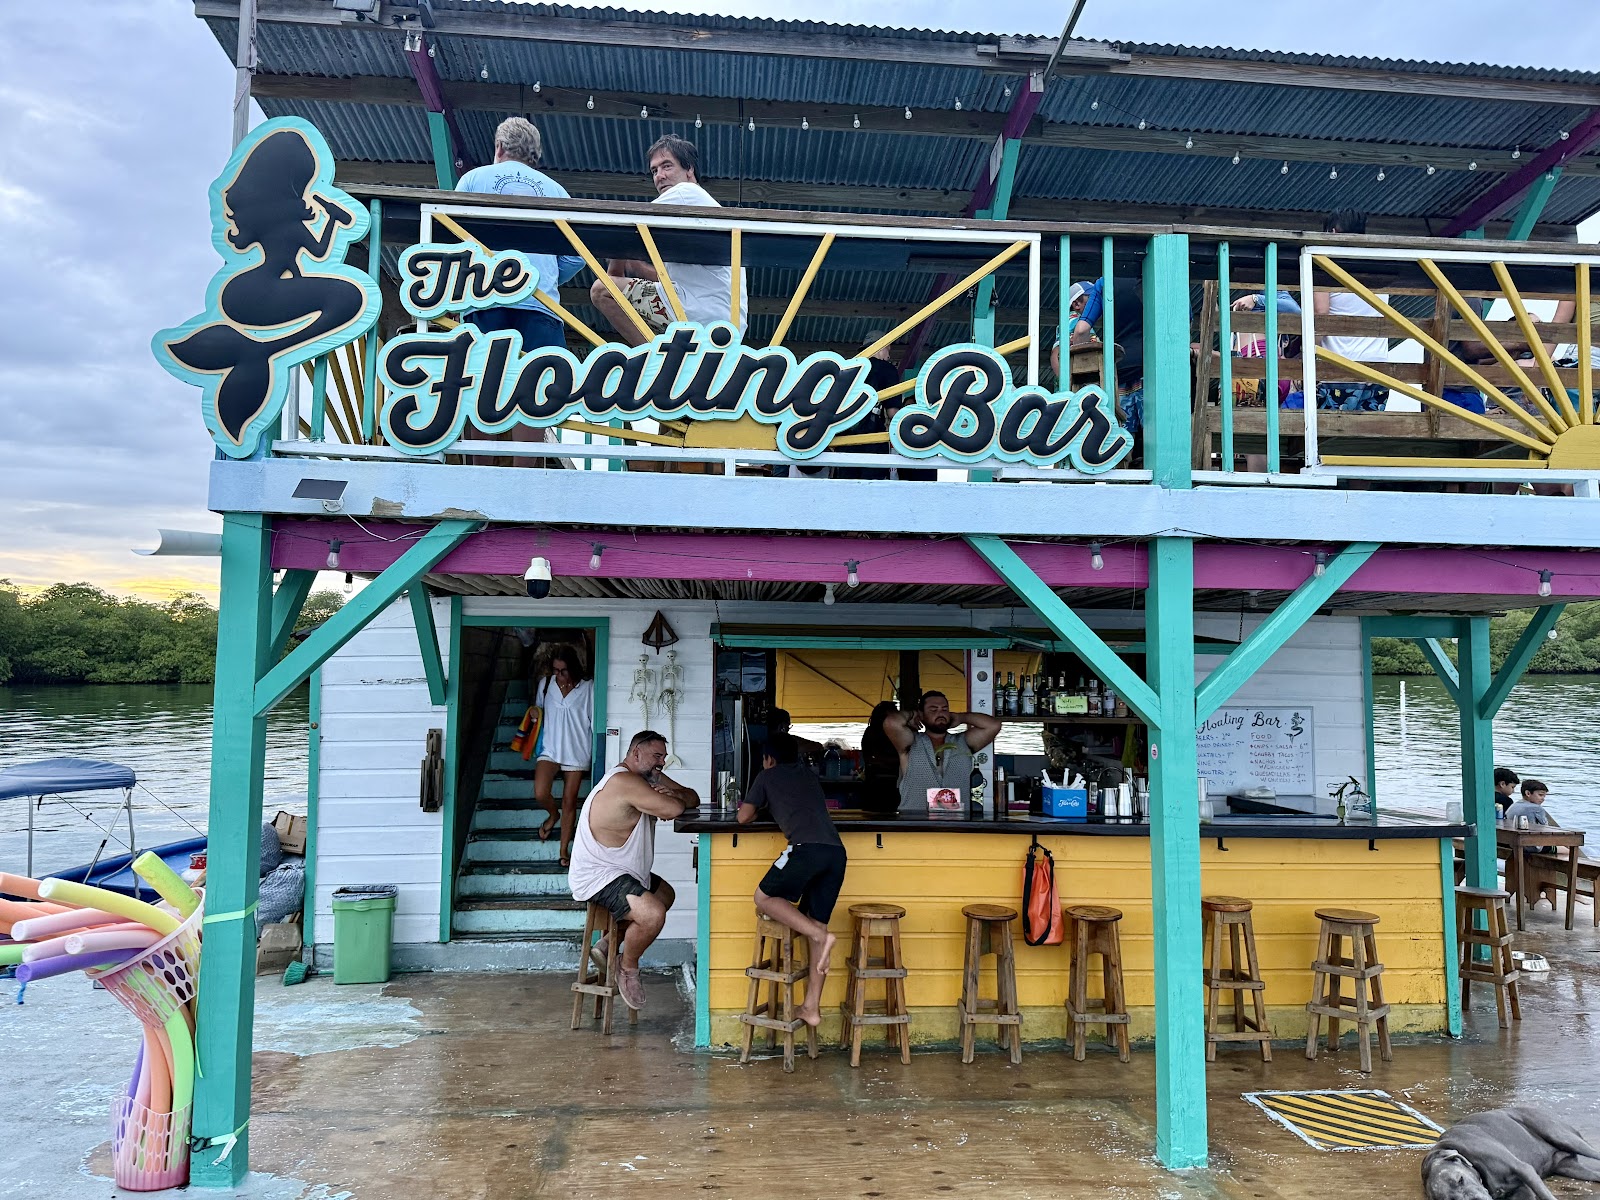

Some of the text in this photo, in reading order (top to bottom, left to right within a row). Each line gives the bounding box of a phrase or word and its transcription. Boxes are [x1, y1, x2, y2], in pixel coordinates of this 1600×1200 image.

[408, 250, 530, 308] The
[385, 326, 1126, 465] Floating Bar
[1250, 732, 1272, 740] FOOD
